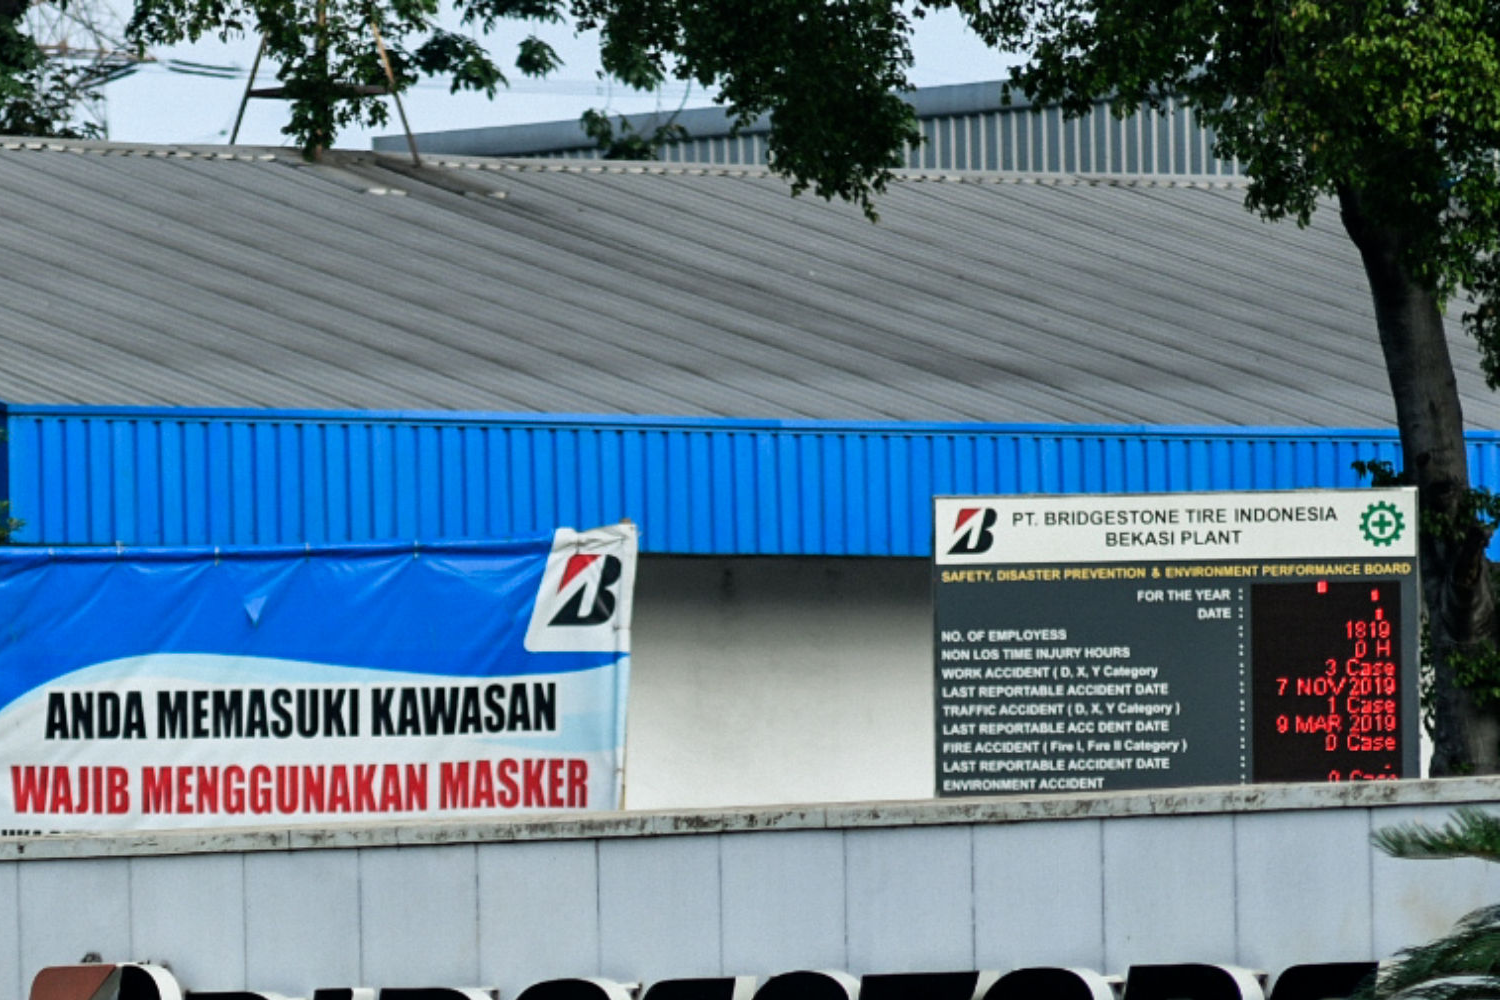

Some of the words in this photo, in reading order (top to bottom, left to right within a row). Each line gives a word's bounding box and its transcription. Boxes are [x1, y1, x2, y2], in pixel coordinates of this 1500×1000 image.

[1012, 512, 1038, 528] PT.
[1045, 508, 1180, 527] BRIDGESTONE
[1186, 508, 1227, 524] TIRE
[1234, 506, 1338, 523] INDONESIA
[1105, 531, 1175, 548] BEKASI
[1181, 530, 1242, 547] PLANT
[996, 569, 1061, 582] DISASTER
[1064, 568, 1146, 580] PREVENTION
[1151, 567, 1161, 579] &
[1165, 566, 1260, 579] ENVIRONMENT
[1262, 564, 1361, 577] PERFORMANCE
[1364, 563, 1412, 575] BOARD
[1136, 590, 1164, 602] FOR
[1167, 589, 1192, 601] THE
[1194, 589, 1231, 601] YEAR
[1197, 607, 1232, 619] DATE
[941, 630, 964, 643] NO.
[967, 630, 986, 642] OF
[988, 628, 1068, 642] EMPLOYESS
[1346, 621, 1391, 638] 1819
[941, 649, 970, 661] NON
[973, 648, 1000, 661] LOS
[1002, 648, 1034, 660] TIME
[1036, 647, 1082, 659] INJURY
[1084, 646, 1131, 658] HOURS
[1376, 640, 1391, 657] H
[941, 667, 983, 680] WORK
[984, 666, 1050, 679] ACCIDENT
[1091, 665, 1101, 677] Y
[1103, 664, 1158, 679] Category
[1325, 659, 1337, 676] 3
[1347, 658, 1396, 676] Case
[942, 686, 976, 698] LAST
[979, 685, 1064, 698] REPORTABLE
[1066, 683, 1132, 696] ACCIDENT
[1135, 683, 1169, 695] DATE
[1276, 678, 1289, 696] 7
[1297, 677, 1346, 696] NOV
[1349, 677, 1396, 695] 2019
[45, 690, 148, 740] ANDA
[157, 686, 360, 739] MEMASUKI
[371, 681, 558, 736] KAWASAN
[942, 704, 997, 717] TRAFFIC
[999, 703, 1065, 716] ACCIDENT
[1105, 702, 1116, 714] Y
[1117, 701, 1173, 716] Category
[1328, 696, 1335, 713] 1
[1347, 697, 1396, 714] Case
[943, 723, 976, 735] LAST
[979, 722, 1065, 735] REPORTABLE
[1135, 720, 1169, 732] DATE
[1276, 714, 1289, 734] 9
[1296, 714, 1342, 734] MAR
[1349, 714, 1396, 732] 2019
[943, 741, 972, 754] FIRE
[974, 740, 1041, 754] ACCIDENT
[1050, 740, 1074, 752] Fire
[1124, 738, 1180, 753] Category
[1347, 734, 1396, 751] Case
[943, 760, 976, 773] LAST
[979, 759, 1065, 772] REPORTABLE
[1067, 758, 1133, 771] ACCIDENT
[1136, 757, 1170, 770] DATE
[11, 764, 130, 815] WAJIB
[142, 762, 428, 815] MENGGUNAKAN
[439, 757, 589, 810] MASKER
[943, 778, 1037, 792] ENVIRONMENT
[1038, 777, 1105, 791] ACCIDENT
